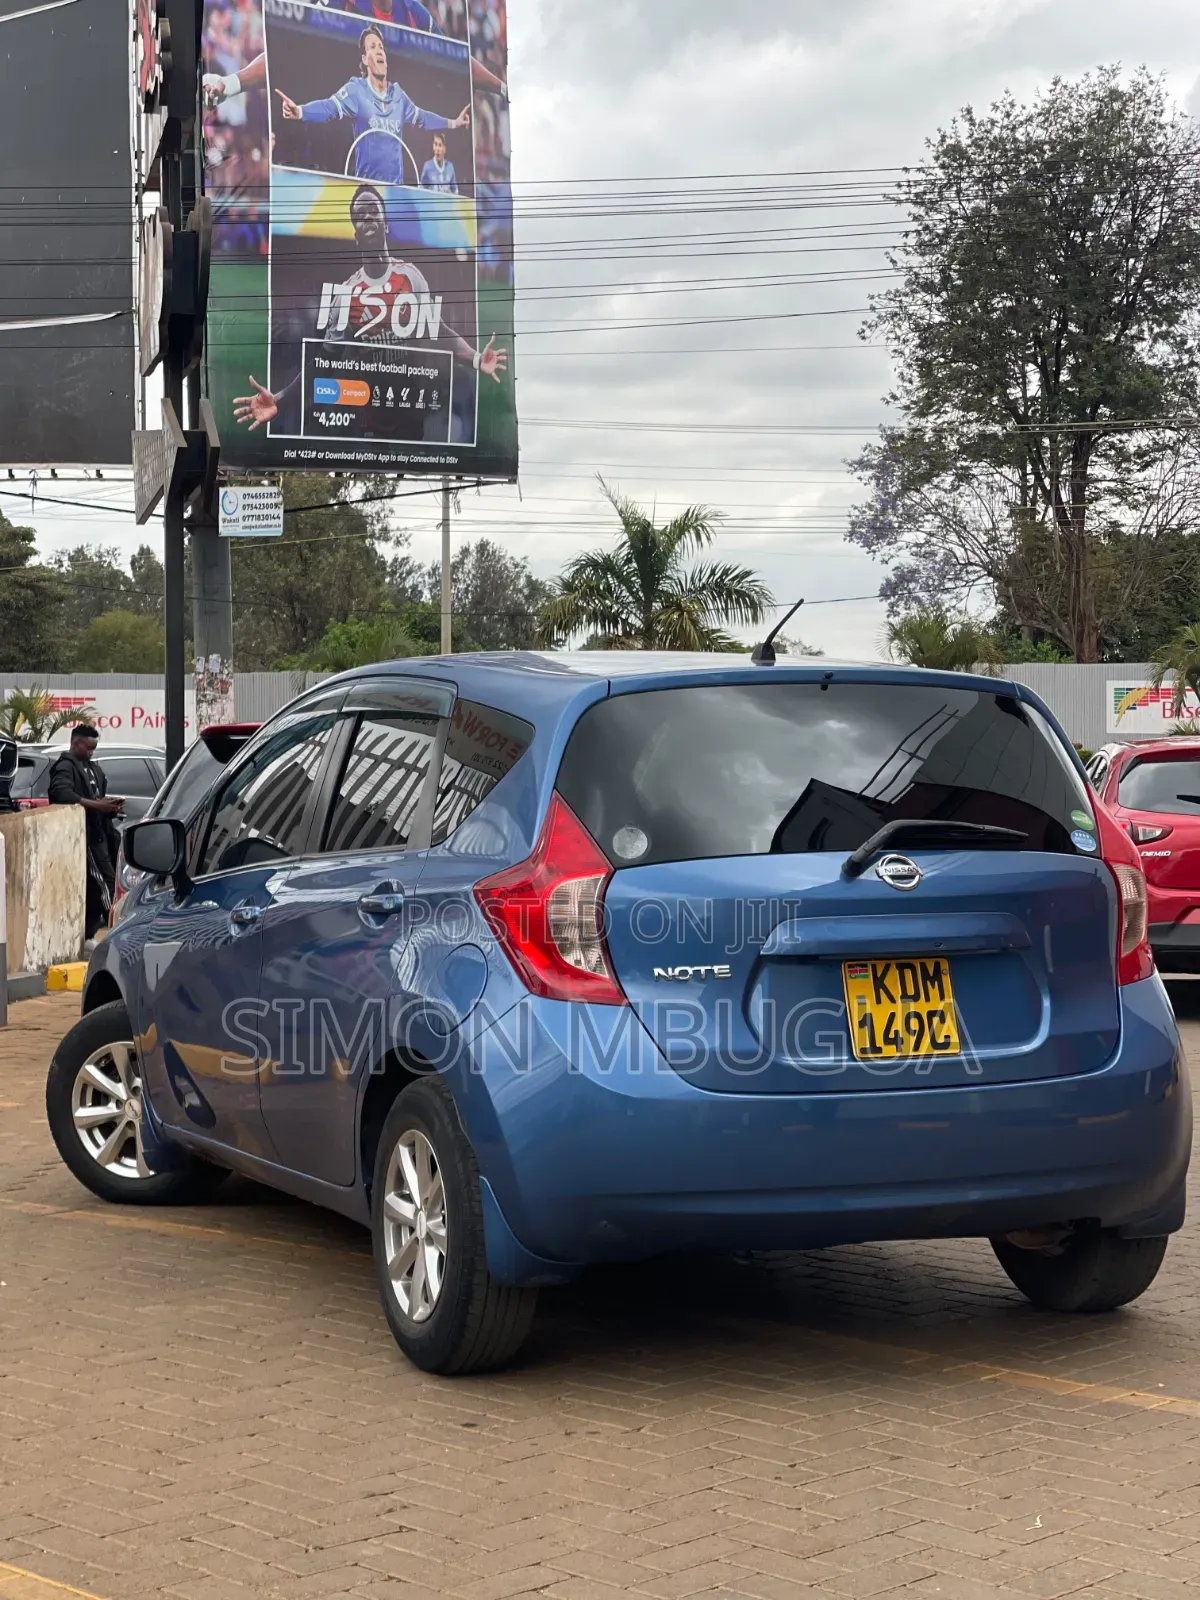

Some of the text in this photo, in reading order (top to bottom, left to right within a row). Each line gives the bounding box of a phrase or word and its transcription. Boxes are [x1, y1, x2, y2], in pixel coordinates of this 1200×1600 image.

[379, 117, 401, 133] MSC
[316, 282, 443, 341] IT'S ON
[314, 357, 439, 380] The world's best football package
[342, 389, 366, 398] Compact
[318, 411, 351, 428] 4,200
[283, 450, 297, 458] Dial
[325, 451, 356, 460] Download
[378, 453, 390, 463] App
[390, 454, 397, 462] to
[397, 454, 410, 465] stay
[409, 454, 440, 464] Connected
[439, 456, 446, 464] to
[884, 866, 918, 874] NISSAN
[653, 964, 732, 981] NOTE
[871, 961, 946, 1004] KDM
[858, 1009, 951, 1054] 149C
